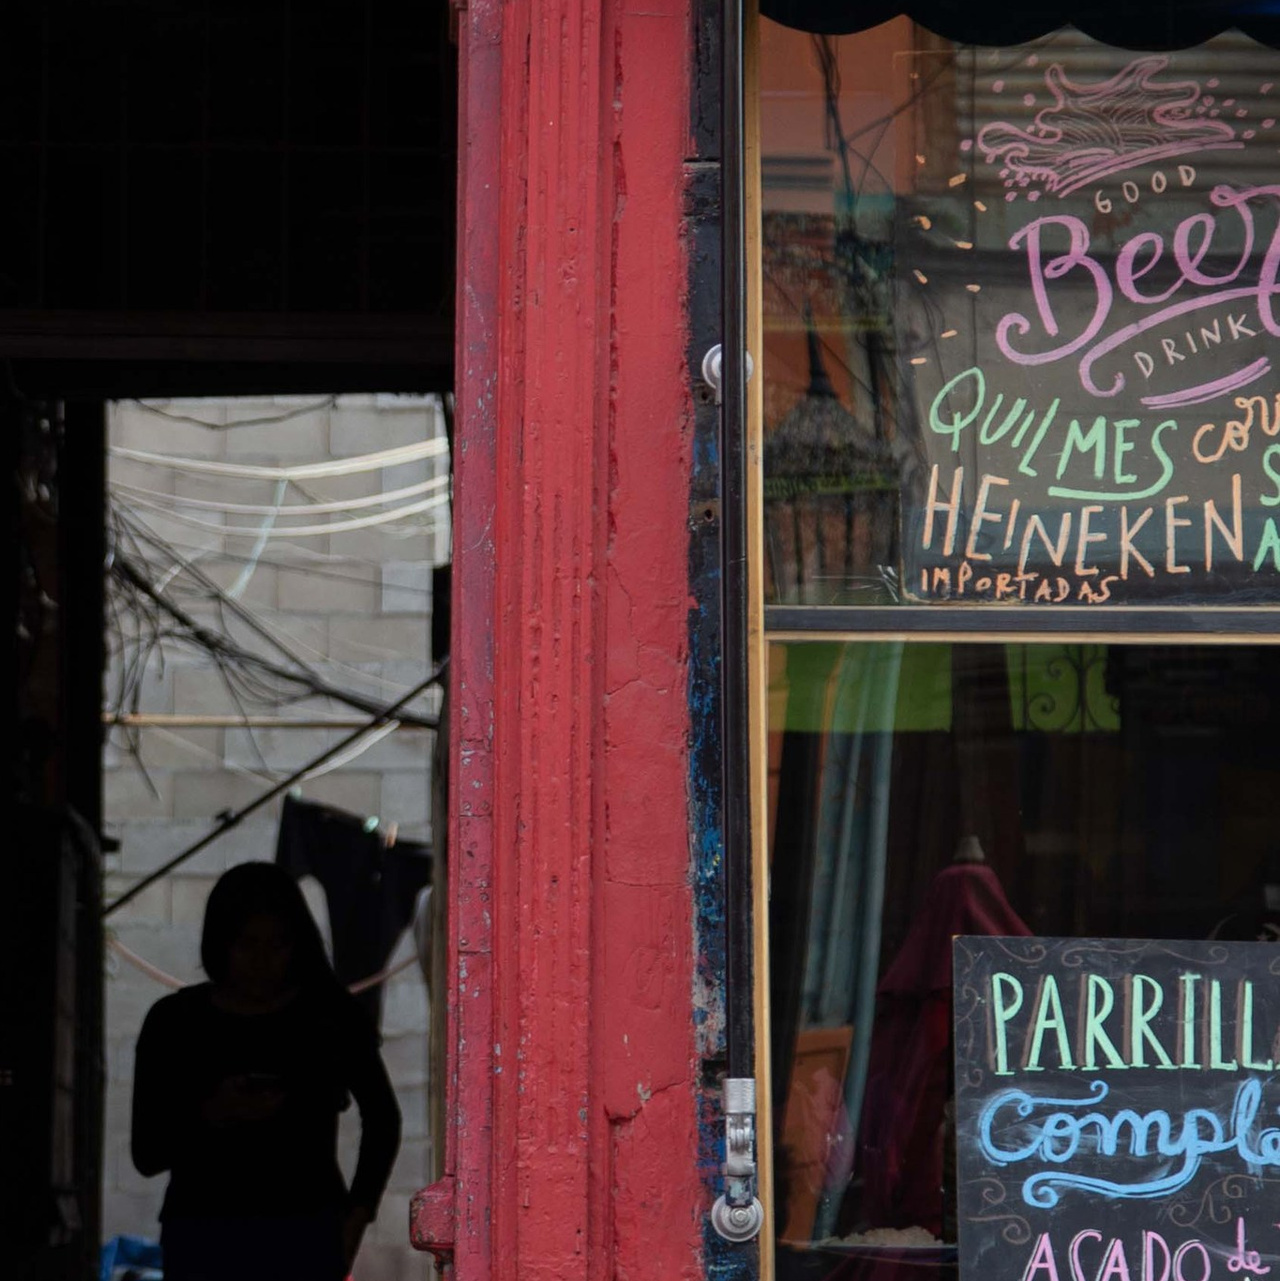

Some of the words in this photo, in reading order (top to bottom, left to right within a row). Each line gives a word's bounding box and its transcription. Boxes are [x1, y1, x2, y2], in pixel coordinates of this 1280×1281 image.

[1095, 164, 1196, 213] GOOD
[1134, 313, 1257, 379] DRINK
[929, 366, 1178, 501] QUILMES
[922, 463, 1244, 580] HEINEKEN
[922, 561, 1119, 604] IMPORTADAS
[990, 971, 1280, 1075] PARRILL
[1228, 1217, 1270, 1274] de
